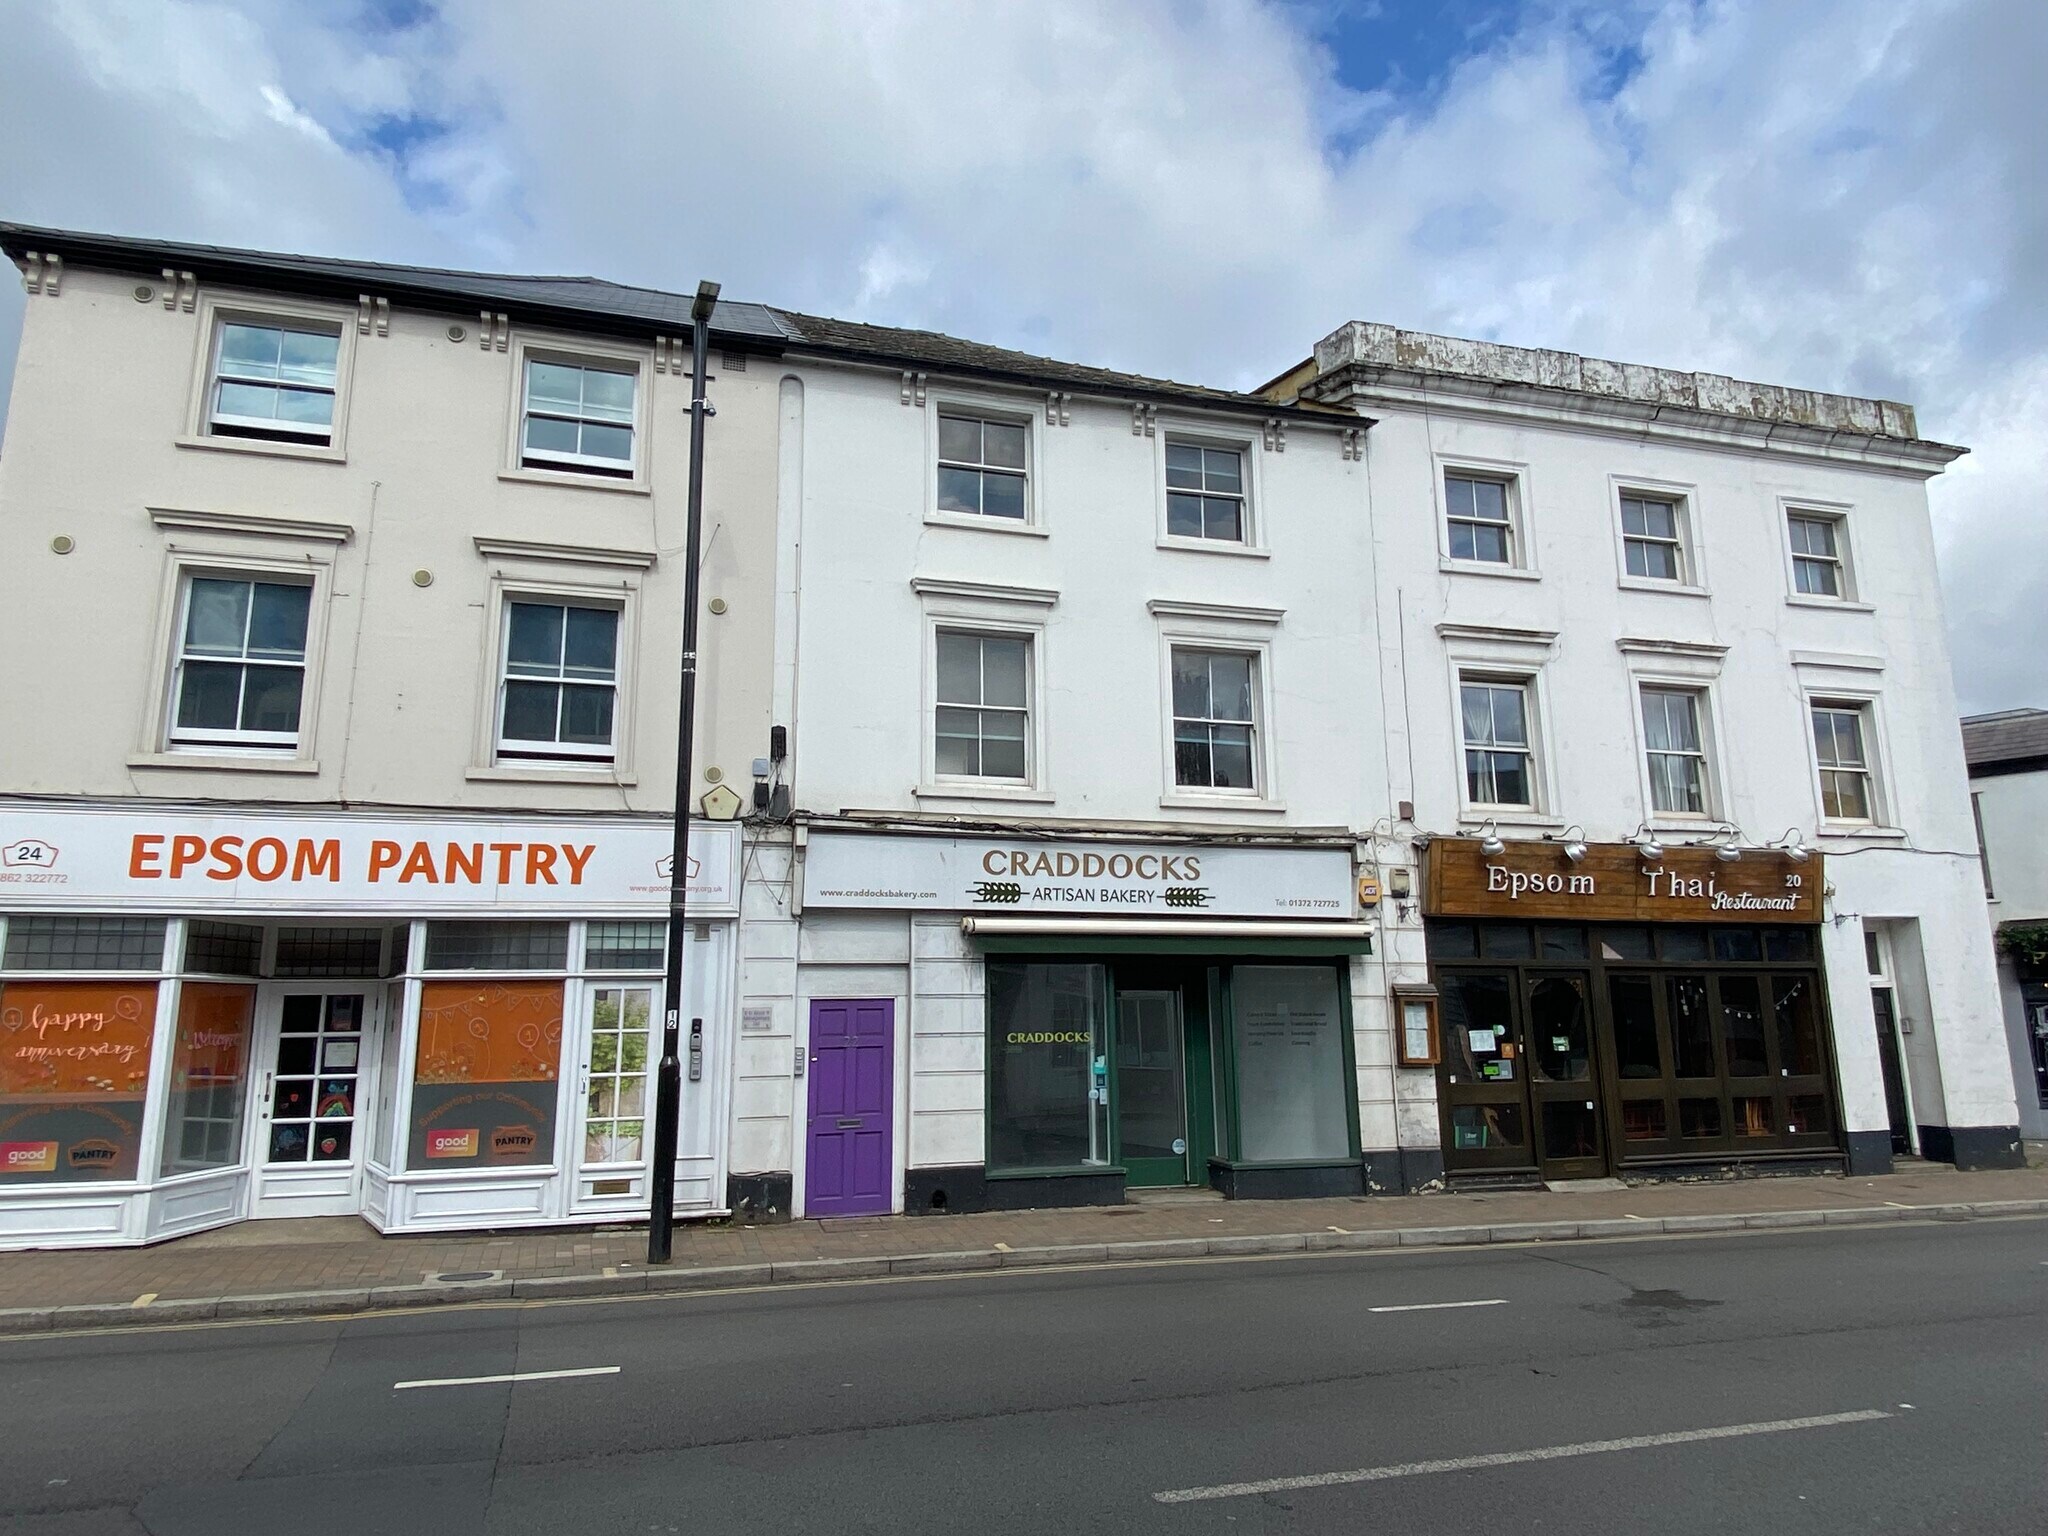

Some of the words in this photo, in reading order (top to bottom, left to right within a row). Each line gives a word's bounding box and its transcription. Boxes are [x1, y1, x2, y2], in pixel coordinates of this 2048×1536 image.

[18, 846, 42, 860] 24
[128, 834, 340, 882] EPSOM
[367, 840, 597, 885] PANTRY
[982, 849, 1201, 881] CRADDOCKS
[24, 873, 69, 884] 322772
[1486, 863, 1595, 899] Epsom
[1641, 866, 1715, 898] Thai
[1785, 874, 1802, 887] 20
[820, 889, 938, 900] www.craddocksbakery.com
[1032, 886, 1095, 903] ARTISAN
[1100, 889, 1155, 904] BAKERY
[1711, 890, 1802, 911] Restaurant
[1288, 899, 1312, 908] 01372
[1313, 900, 1341, 908] 727725
[22, 1003, 116, 1040] happy
[1007, 1031, 1091, 1043] CRADDOCKS
[435, 1133, 469, 1150] good
[495, 1136, 533, 1146] PANTRY
[8, 1146, 47, 1163] good
[72, 1150, 117, 1160] PANTRY
